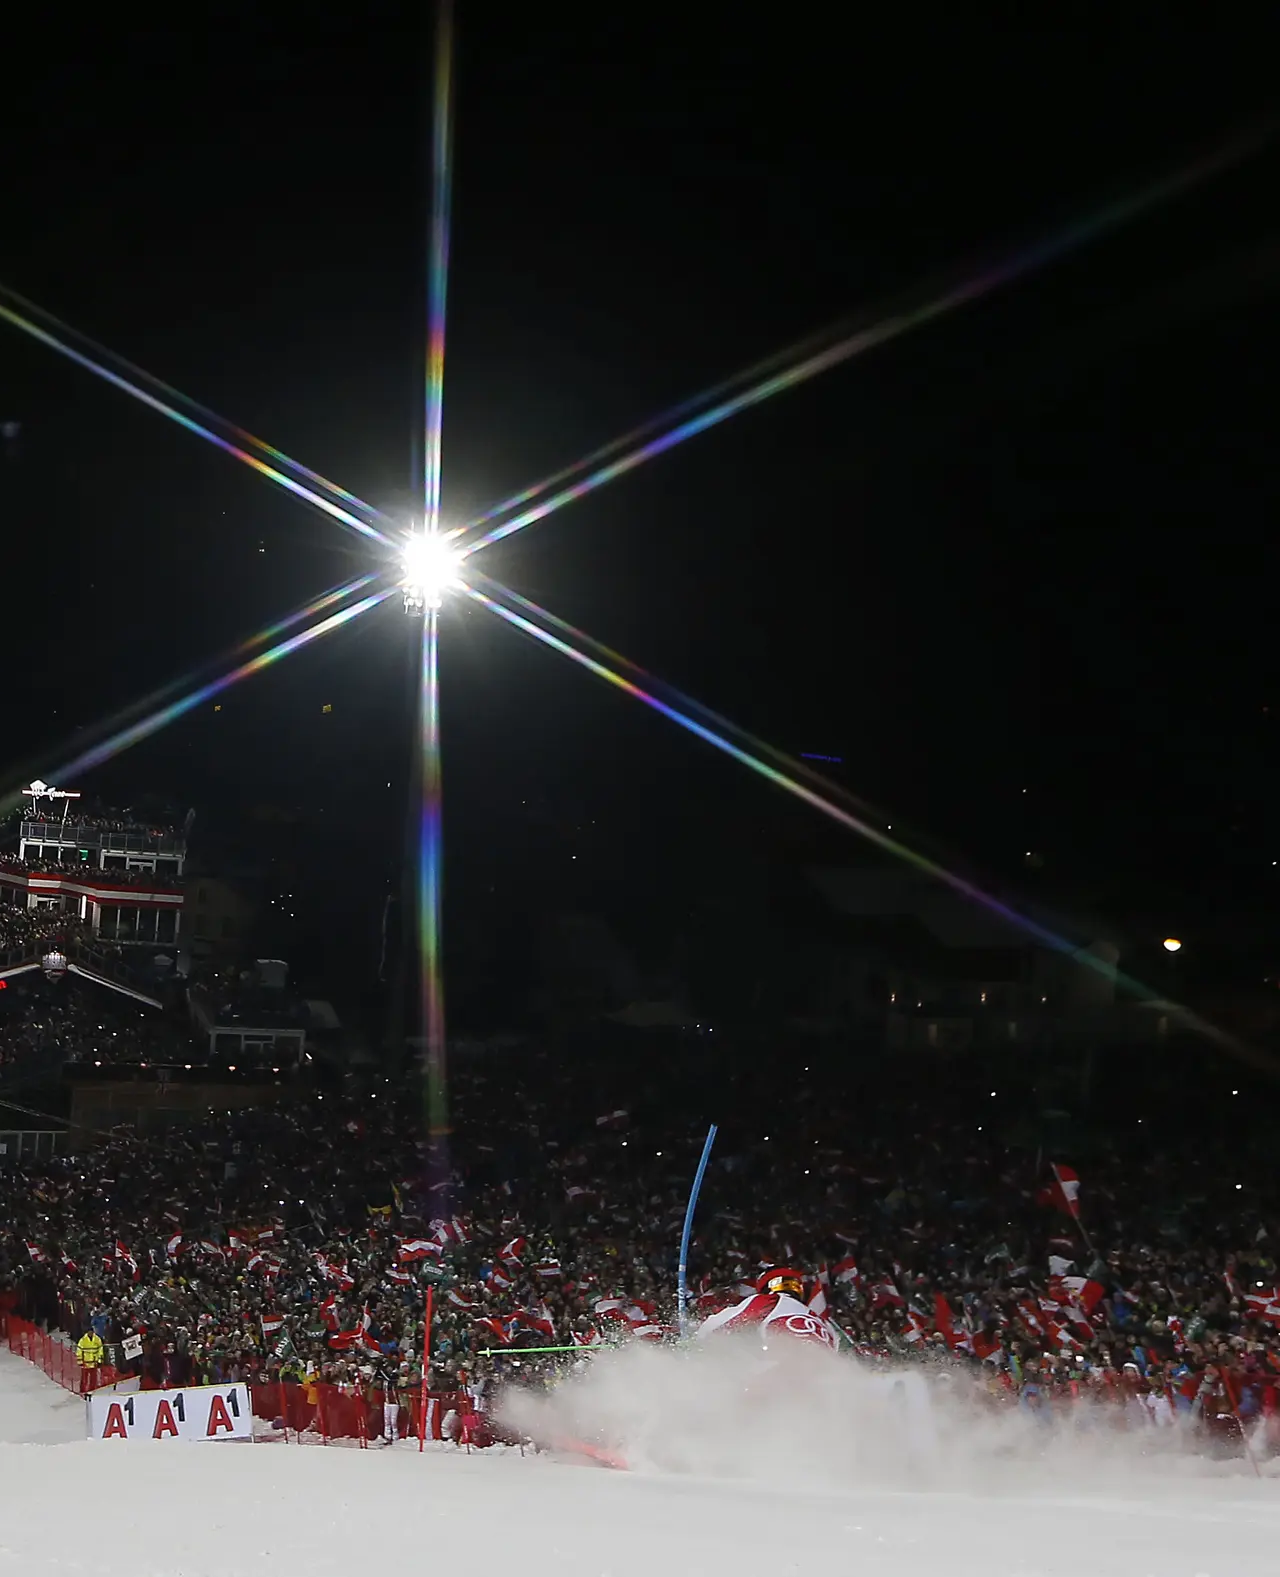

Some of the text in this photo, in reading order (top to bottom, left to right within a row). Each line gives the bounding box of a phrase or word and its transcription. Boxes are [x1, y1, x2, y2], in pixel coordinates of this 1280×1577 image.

[102, 1388, 239, 1439] A1 A1 A1
